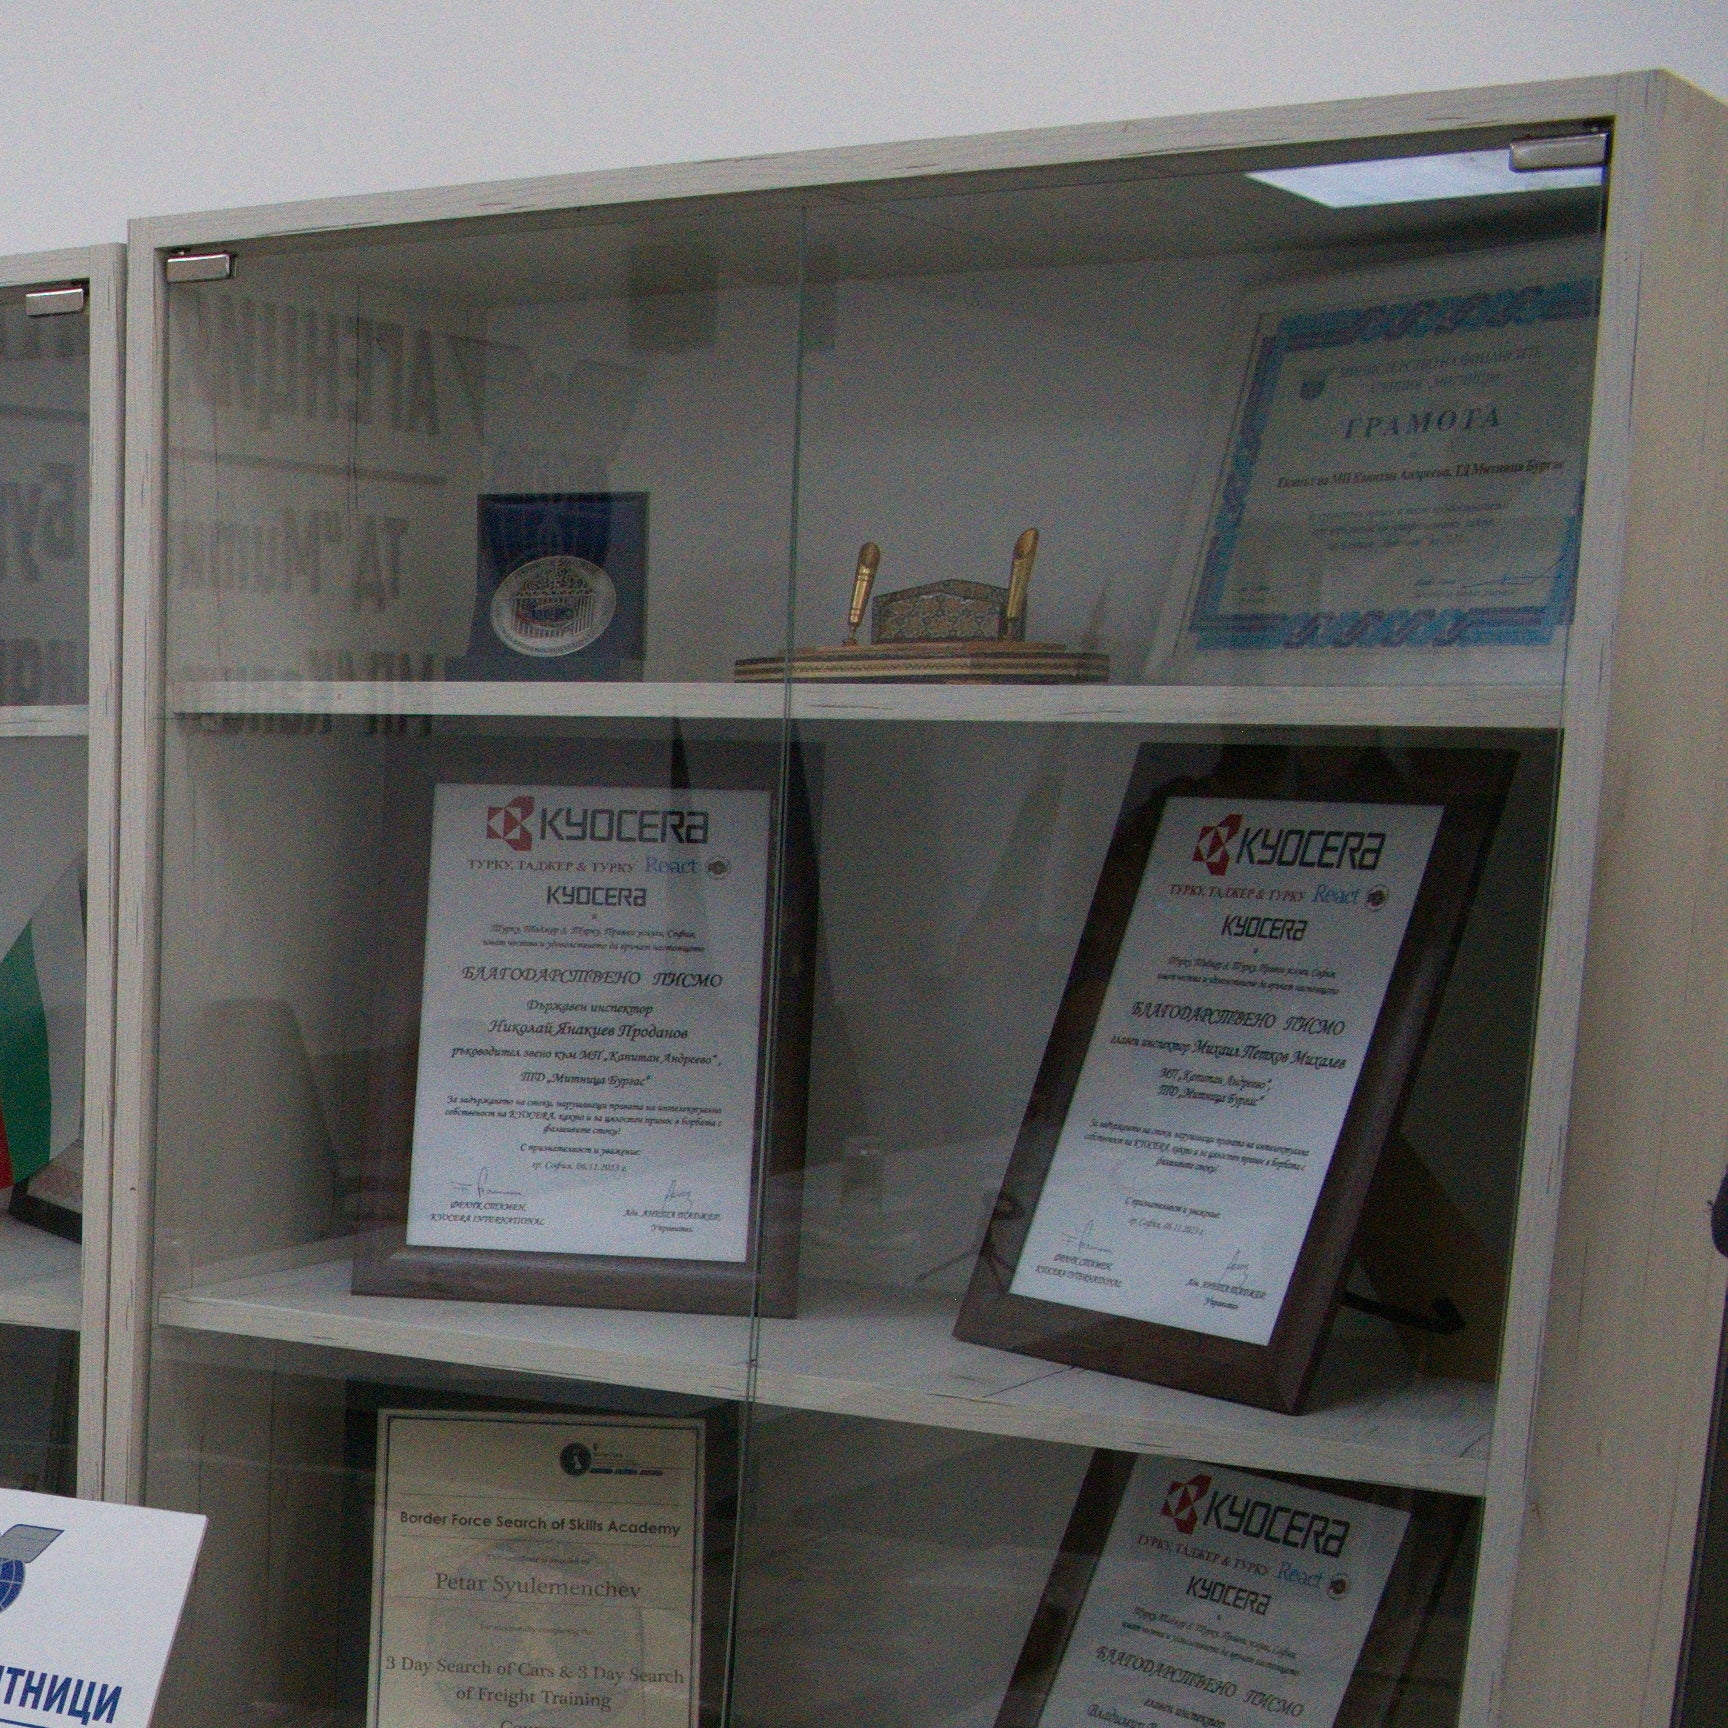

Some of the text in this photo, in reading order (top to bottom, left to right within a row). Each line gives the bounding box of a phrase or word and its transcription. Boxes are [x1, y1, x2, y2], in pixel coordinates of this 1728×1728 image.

[1344, 407, 1500, 439] ГРАМОТА
[400, 1511, 681, 1537] Border Force Search of Skills Academy
[436, 1572, 485, 1591] Petar
[386, 1656, 395, 1669] 3
[401, 1657, 429, 1676] Day
[436, 1660, 491, 1675] Search
[497, 1661, 514, 1675] of
[518, 1662, 554, 1677] Cars
[593, 1666, 624, 1685] Day
[630, 1668, 684, 1684] Search
[456, 1686, 612, 1711] of Freight Training
